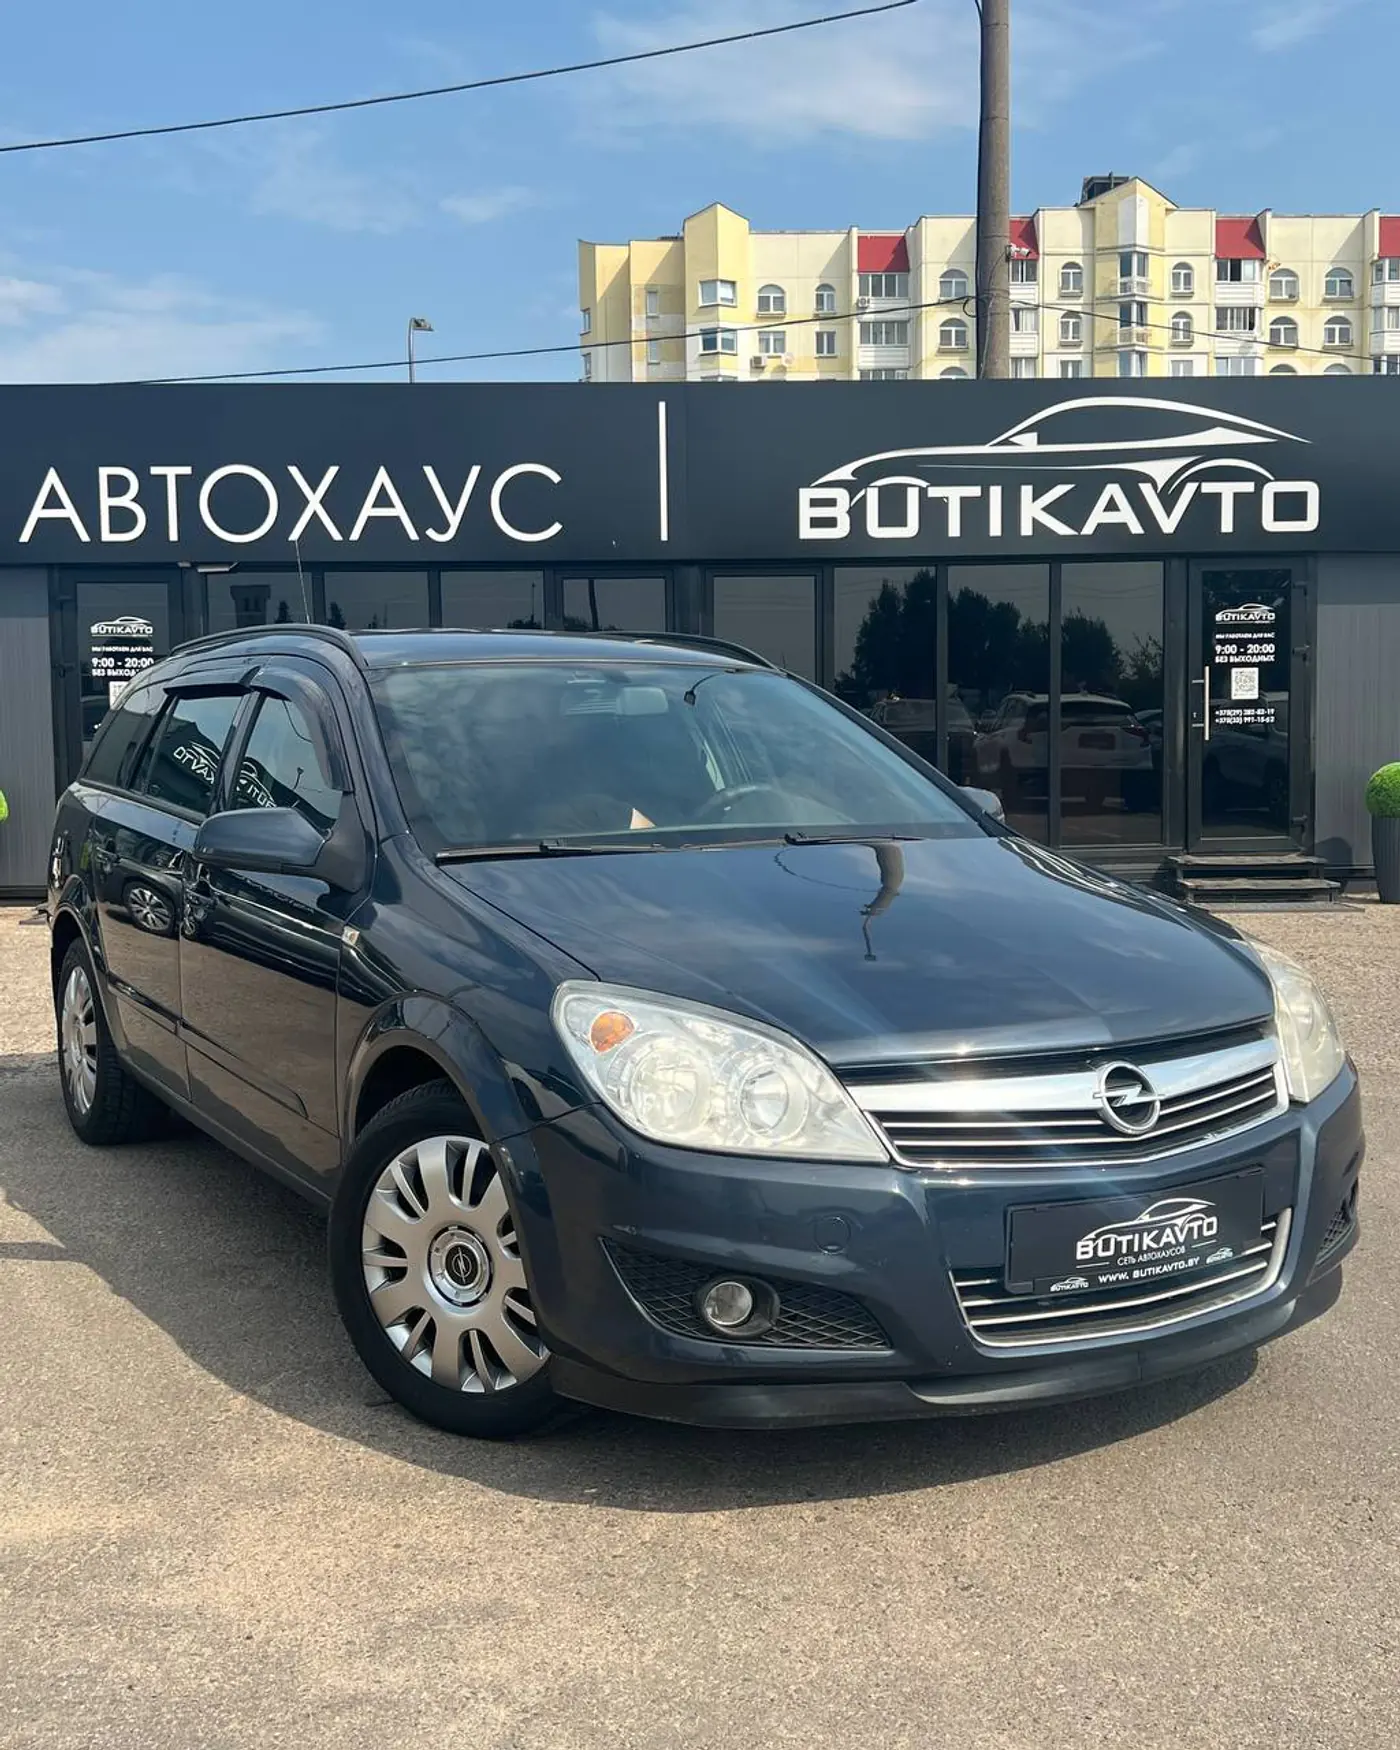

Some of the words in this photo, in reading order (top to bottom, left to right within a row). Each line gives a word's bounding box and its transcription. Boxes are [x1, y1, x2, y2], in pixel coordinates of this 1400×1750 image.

[19, 463, 563, 543] АВТОХАУС
[798, 480, 1320, 540] BUTIKAVTO
[1215, 612, 1275, 621] BUTIKAVTO
[91, 625, 153, 634] BUTIKAVTO
[1215, 643, 1237, 654] 9:00
[1246, 643, 1275, 653] 20:00
[91, 657, 115, 668] 9:00
[1075, 1215, 1218, 1260] BUTIKAVTO
[1117, 1255, 1137, 1267] СЕТЬ
[1137, 1246, 1186, 1263] АВТОХАУСОВ
[1098, 1271, 1129, 1284] WWW.
[1133, 1256, 1200, 1279] BUTIKAVTO.BY
